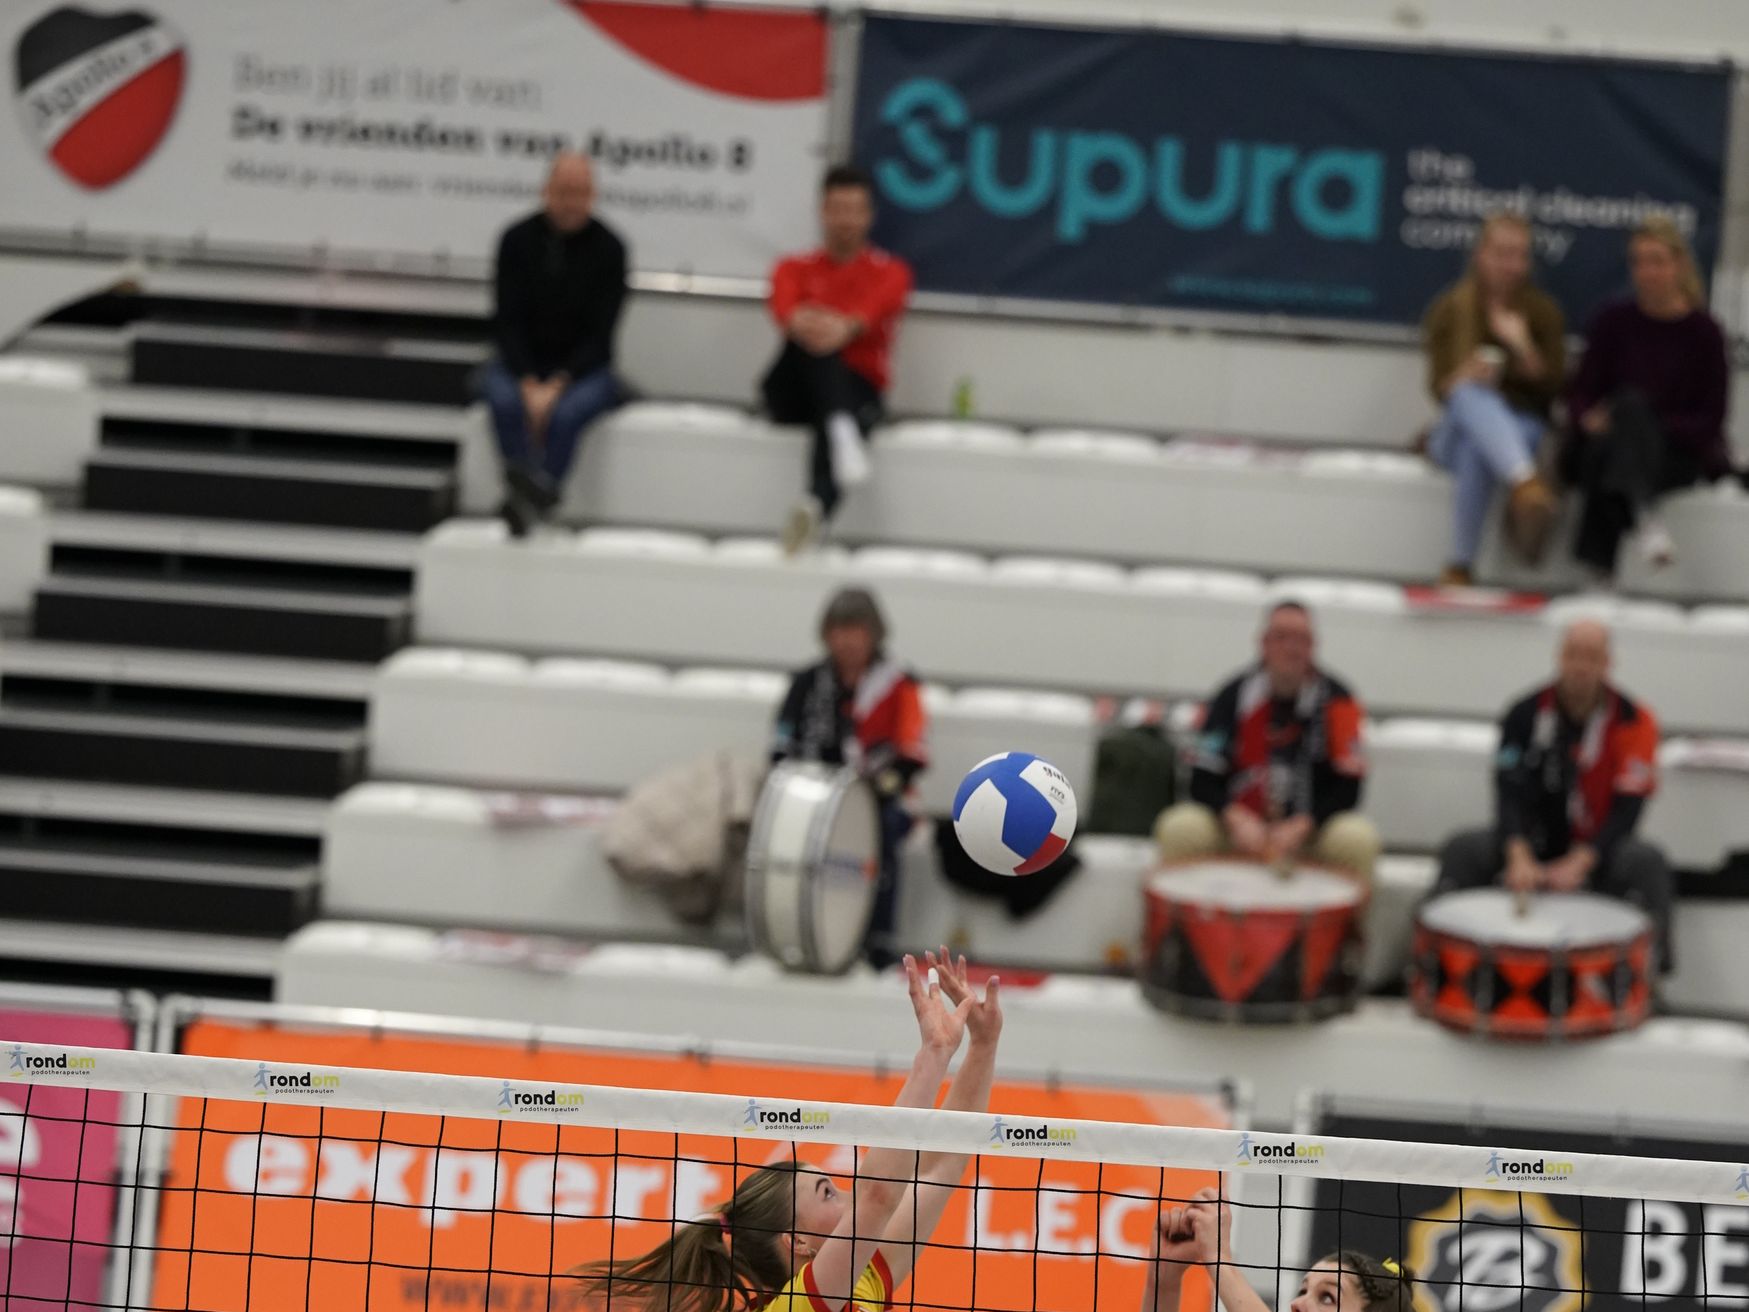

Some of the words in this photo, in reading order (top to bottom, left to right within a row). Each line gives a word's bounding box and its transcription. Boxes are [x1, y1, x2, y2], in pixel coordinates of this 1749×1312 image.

[230, 104, 282, 143] De
[588, 129, 716, 173] Apollo
[875, 77, 1386, 244] Supura
[1406, 148, 1474, 183] the
[26, 1054, 95, 1069] rondom
[31, 1069, 90, 1077] podotherapeuten
[270, 1072, 340, 1088] rondom
[515, 1090, 584, 1106] rondom
[760, 1109, 830, 1124] rondom
[1006, 1125, 1076, 1140] rondom
[1253, 1142, 1324, 1158] rondom
[1502, 1159, 1573, 1175] rondom
[224, 1134, 722, 1230] expert
[1619, 1199, 1749, 1309] BE
